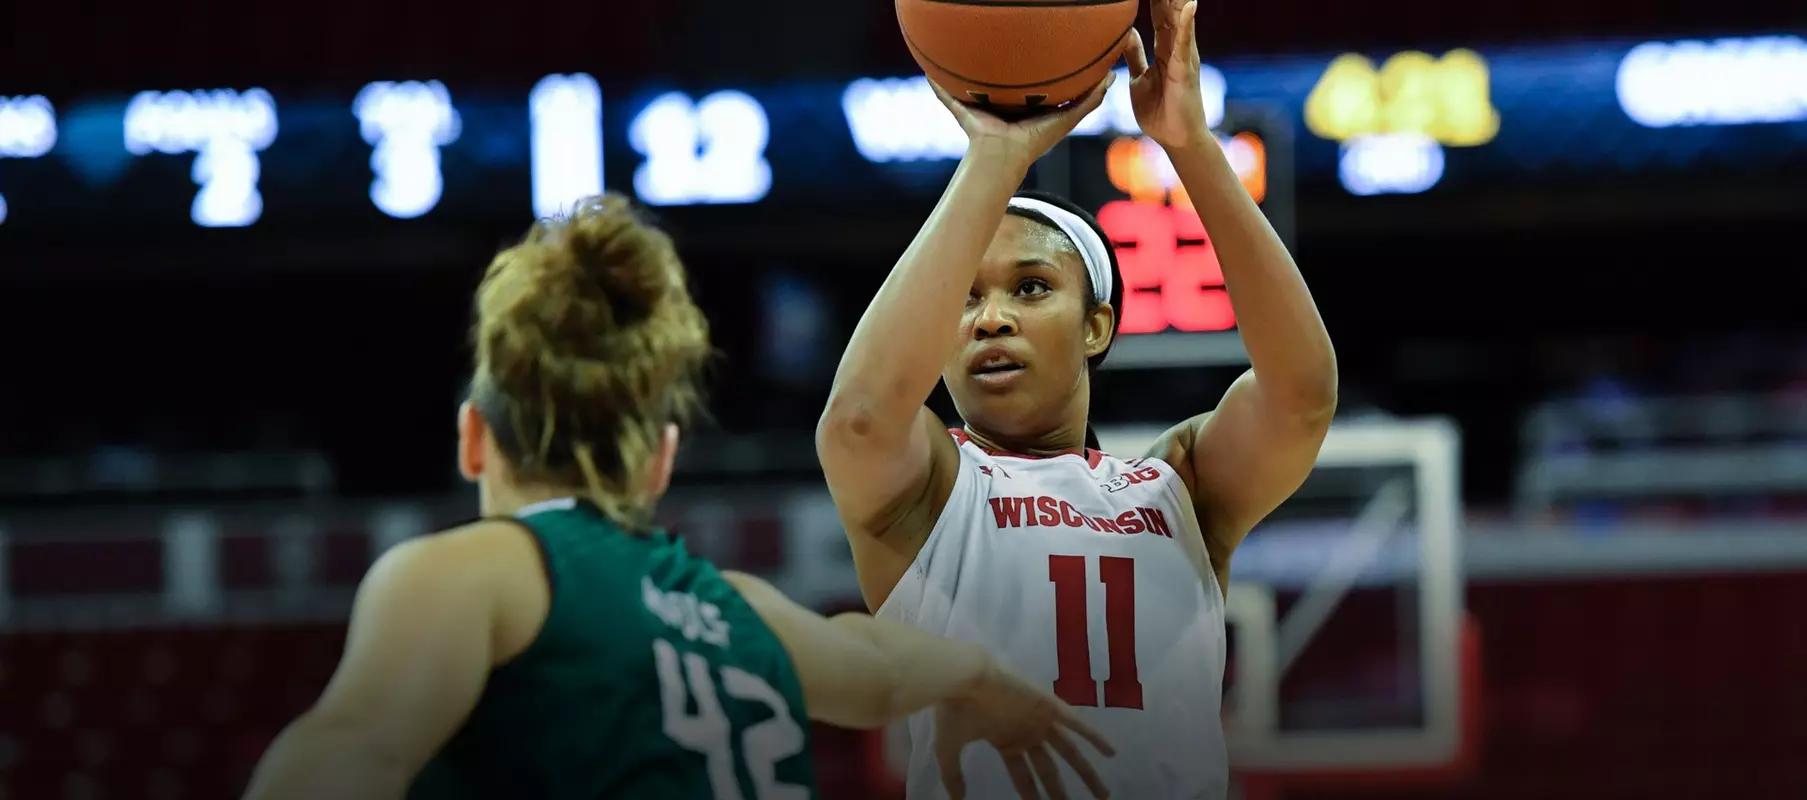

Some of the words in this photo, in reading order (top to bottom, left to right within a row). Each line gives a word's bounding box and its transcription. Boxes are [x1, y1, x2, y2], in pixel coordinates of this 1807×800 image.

[989, 496, 1173, 539] WISCONSIN
[1100, 466, 1161, 493] BIG
[1049, 554, 1144, 710] 11
[652, 637, 811, 799] 42
